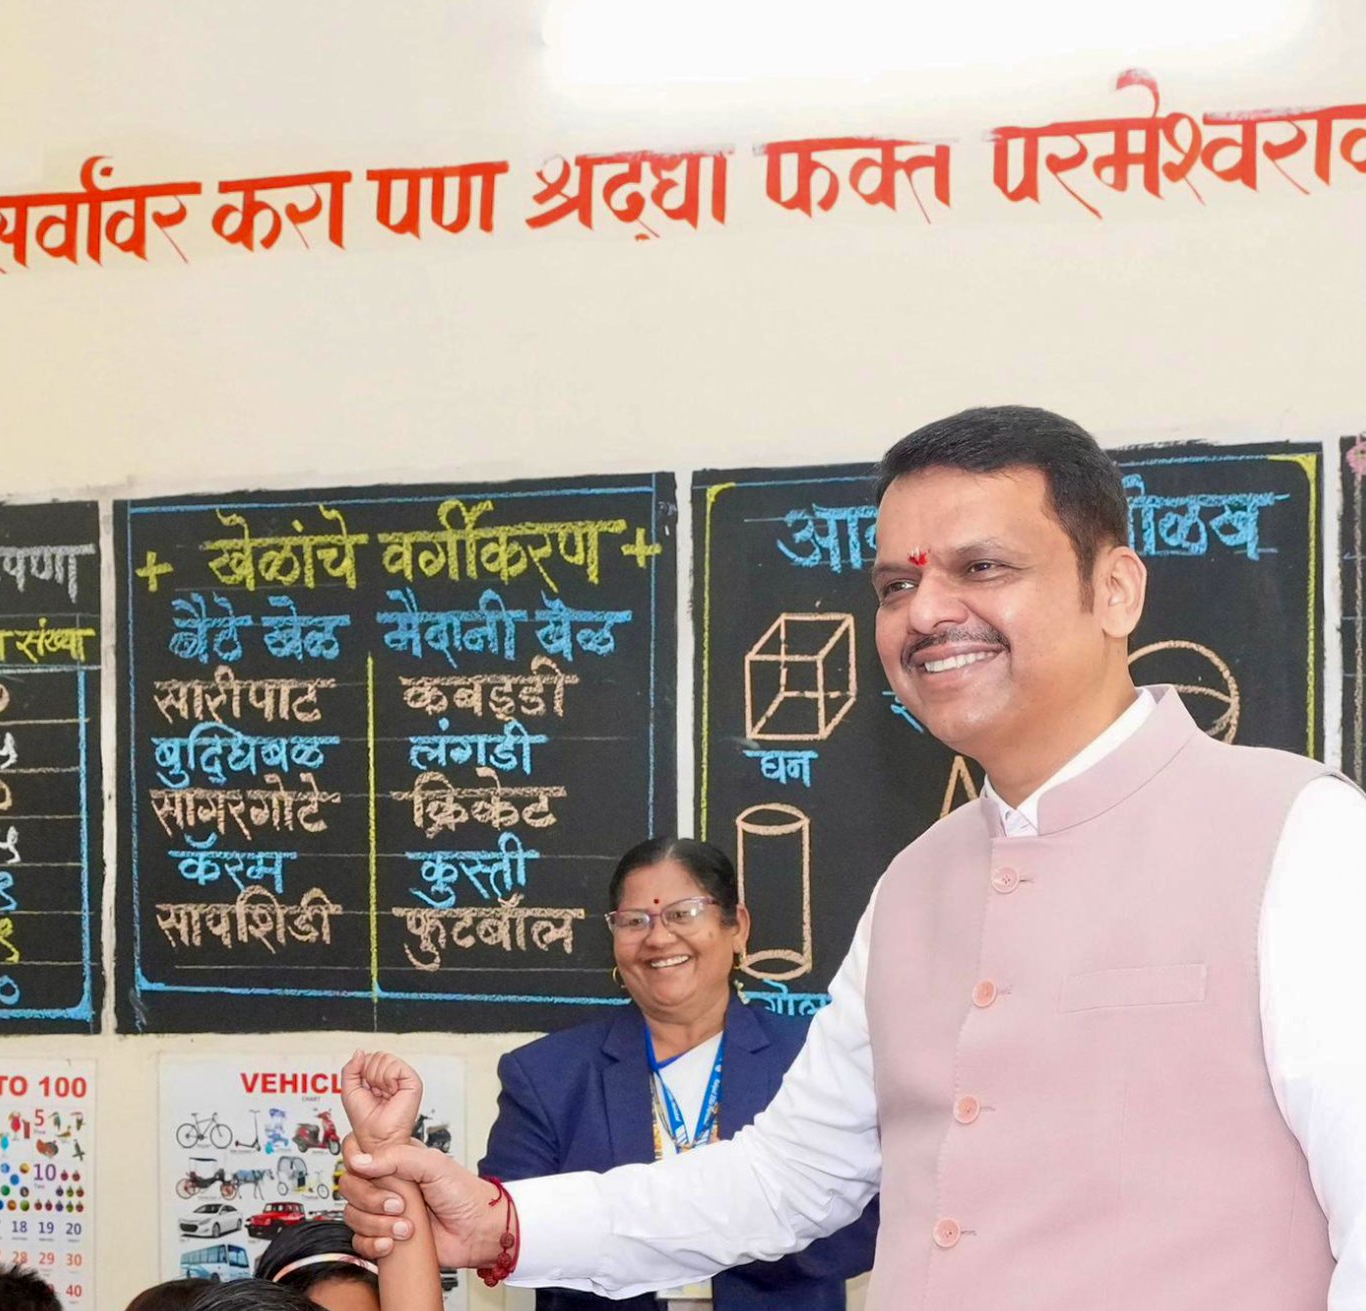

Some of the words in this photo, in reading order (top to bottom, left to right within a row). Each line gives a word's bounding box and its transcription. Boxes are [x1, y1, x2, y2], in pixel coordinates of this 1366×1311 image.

[211, 171, 351, 251] करा
[368, 161, 508, 239] पण
[753, 135, 959, 225] फक्त
[203, 505, 369, 590] खेळांचे
[378, 499, 627, 593] वर्गीकरण
[14, 618, 96, 662] संख्या
[262, 596, 351, 661] खेळ
[377, 588, 528, 668] मैदानी
[535, 593, 632, 661] खेळ
[153, 664, 336, 723] सारीपाट
[409, 717, 549, 775] लंगडी
[744, 750, 819, 788] घन
[150, 773, 341, 842] सागरगोटे
[390, 768, 567, 838] क्रिकेट
[168, 834, 298, 895] कॅरम
[405, 832, 540, 910] कुस्ती
[156, 885, 343, 954] सापशिडी
[393, 894, 586, 971] फुटबॉल
[39, 1077, 87, 1098] 100
[240, 1072, 342, 1095] VEHICL
